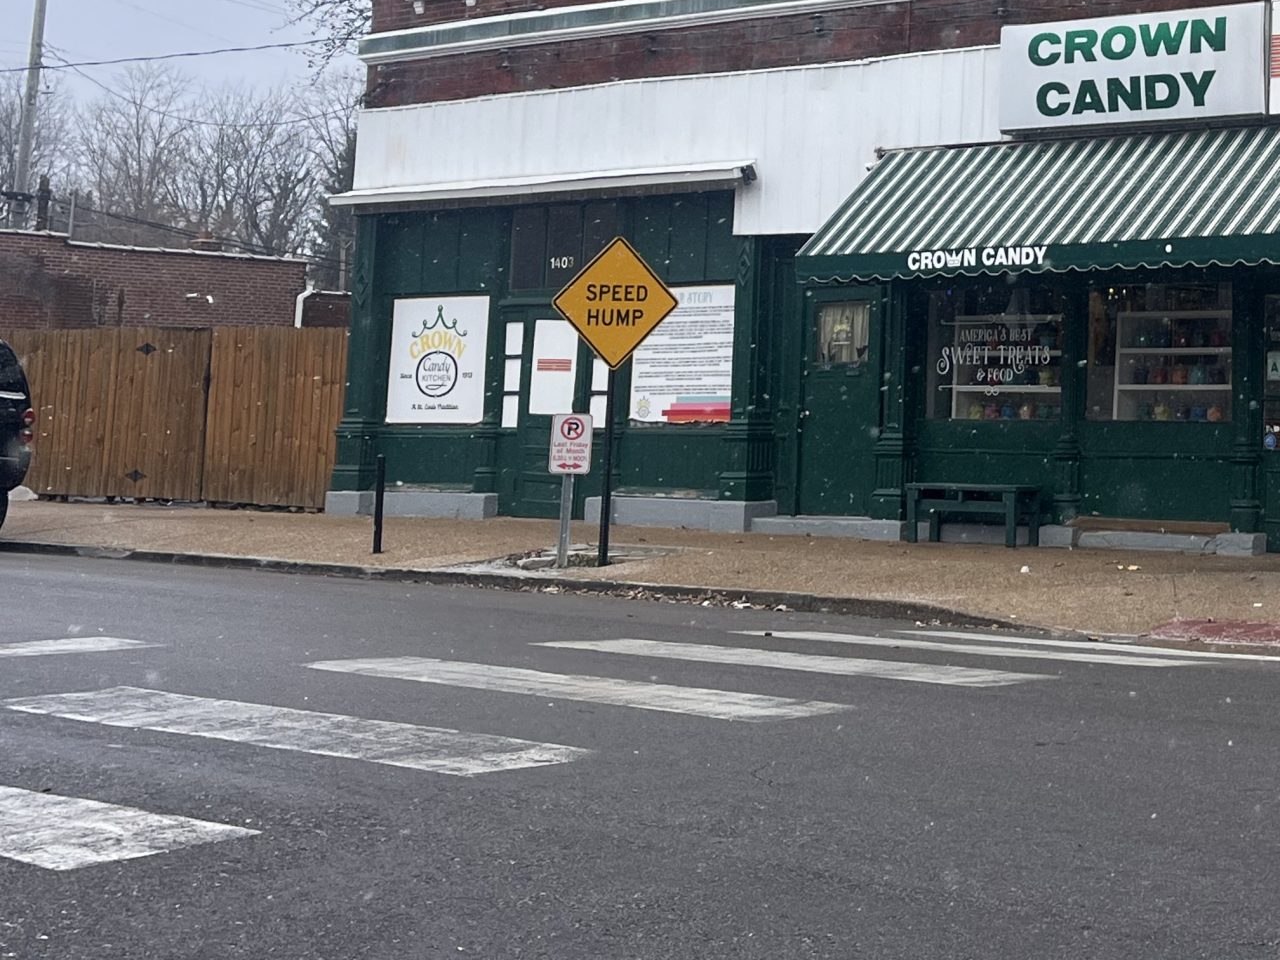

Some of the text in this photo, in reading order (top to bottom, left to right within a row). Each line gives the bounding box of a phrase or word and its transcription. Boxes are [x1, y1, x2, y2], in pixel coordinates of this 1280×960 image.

[1027, 16, 1227, 67] CROWN
[1036, 69, 1217, 117] CANDY
[550, 256, 575, 269] 1403
[907, 246, 1048, 271] CROWN CANDY
[585, 284, 649, 302] SPEED
[586, 308, 644, 327] HUMP
[960, 325, 1034, 342] AMERICA'S BEST
[409, 330, 467, 360] CROWN
[423, 356, 451, 373] Candy
[936, 342, 1051, 375] SWEET TREATS
[1270, 361, 1279, 373] A
[421, 374, 452, 383] KITCHEN
[976, 367, 1014, 382] & FOOD
